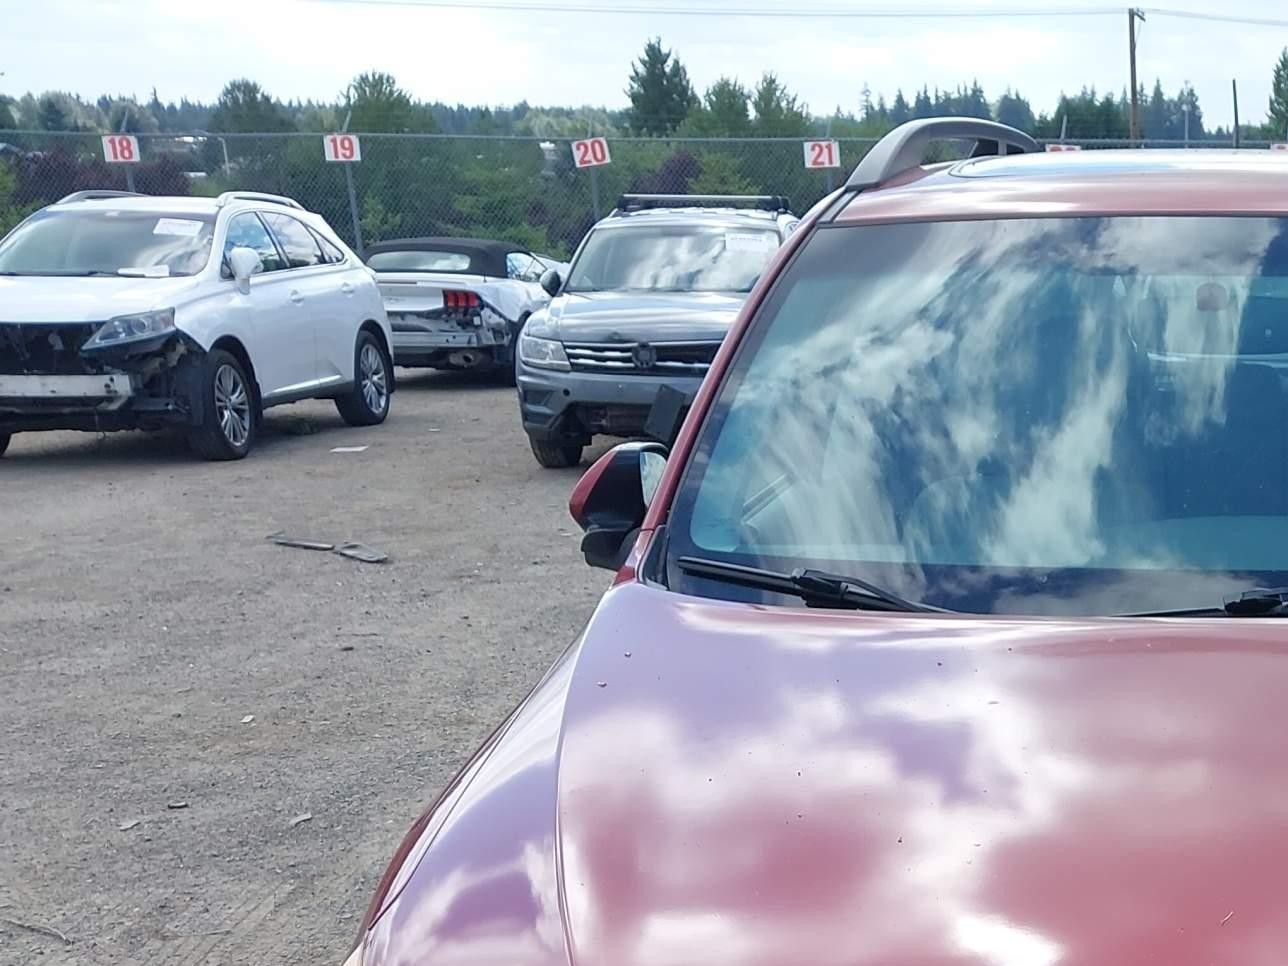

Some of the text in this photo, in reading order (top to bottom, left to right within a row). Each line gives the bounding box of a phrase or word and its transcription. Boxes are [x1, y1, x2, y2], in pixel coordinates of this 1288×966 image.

[106, 135, 134, 160] 18
[328, 135, 355, 160] 19
[575, 139, 606, 165] 20
[810, 142, 834, 166] 21
